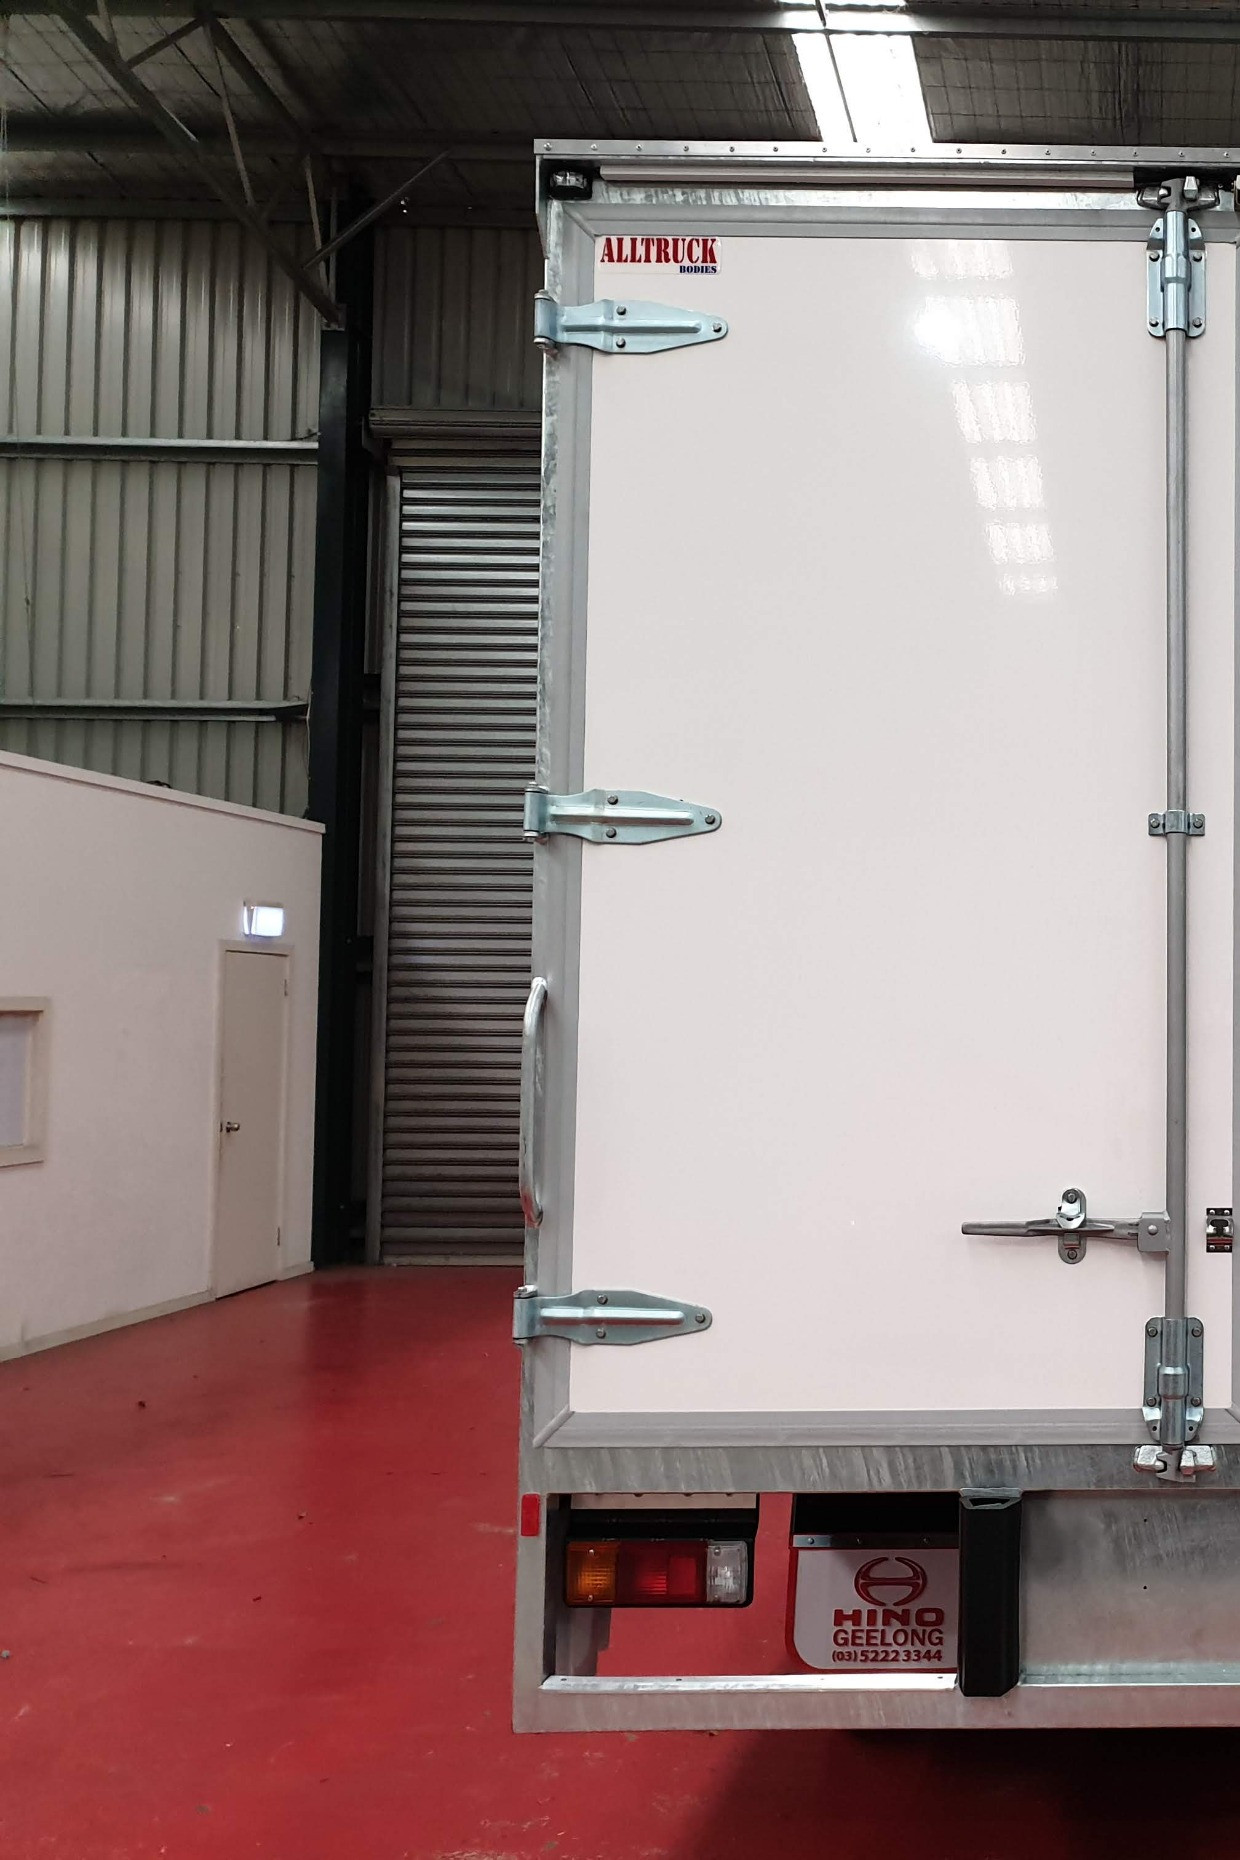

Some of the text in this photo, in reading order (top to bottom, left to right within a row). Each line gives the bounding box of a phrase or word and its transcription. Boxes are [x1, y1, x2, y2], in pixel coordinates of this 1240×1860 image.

[600, 237, 717, 264] ALLTRUCK
[679, 265, 717, 274] BODIES
[833, 1607, 945, 1627] HINO
[833, 1628, 944, 1646] GEELONG
[832, 1649, 943, 1663] (03) 5222 3344
